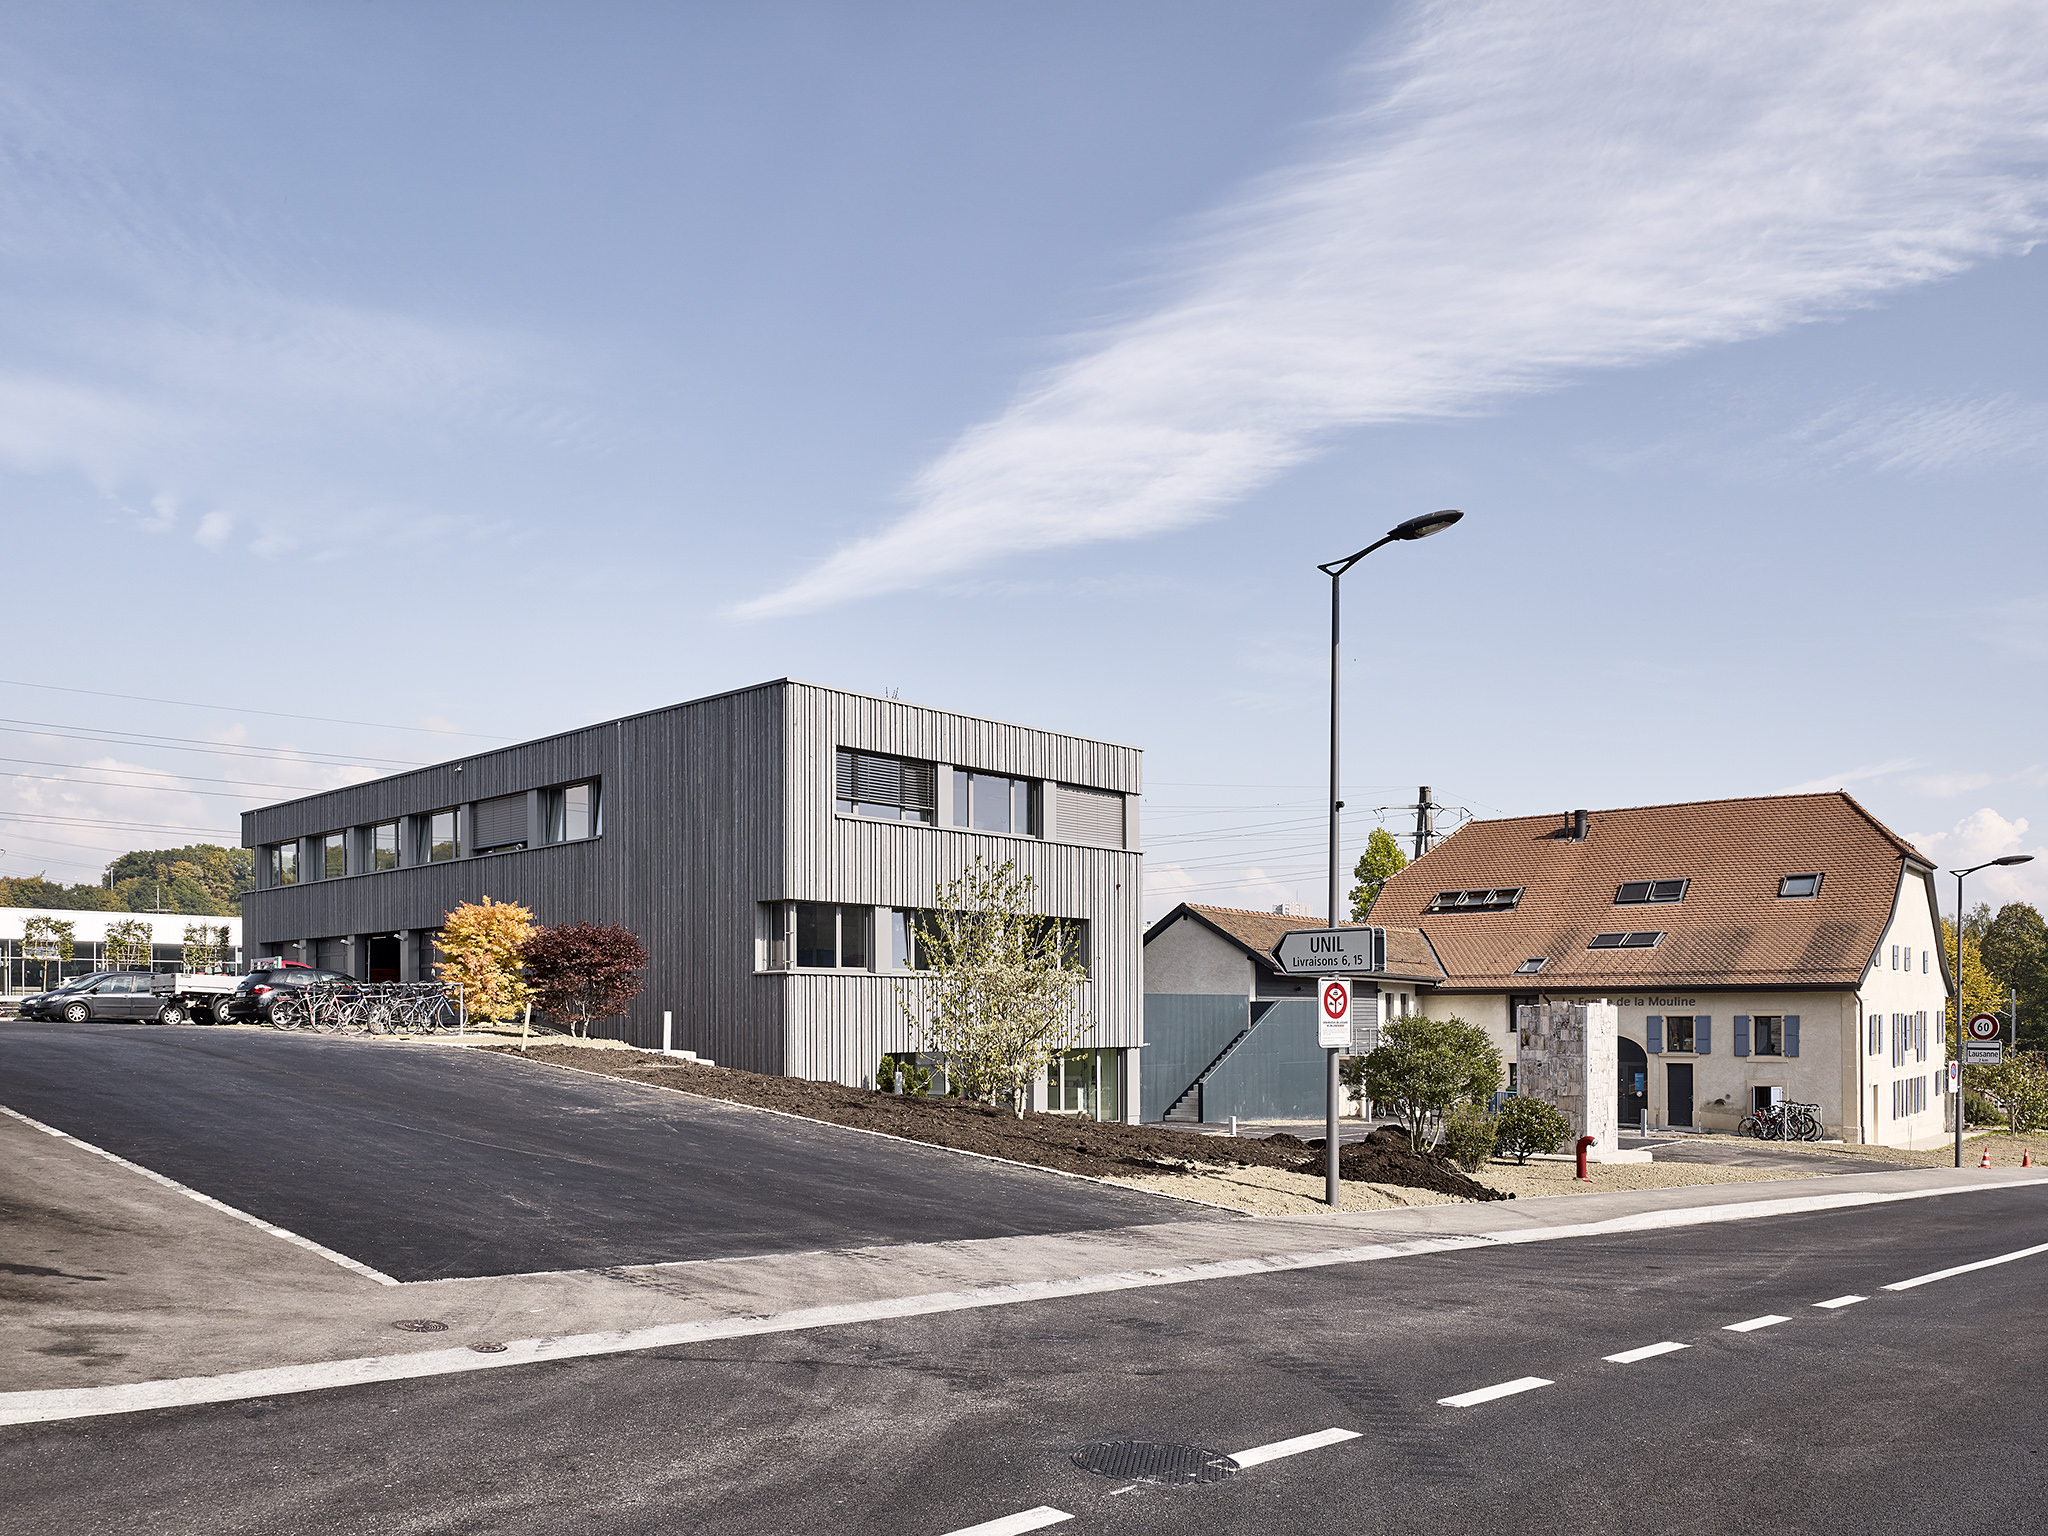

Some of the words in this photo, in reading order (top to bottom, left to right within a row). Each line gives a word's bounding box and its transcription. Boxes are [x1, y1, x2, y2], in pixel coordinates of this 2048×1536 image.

[1310, 936, 1344, 953] UNIL
[1293, 956, 1338, 967] Livraisons
[1341, 955, 1351, 967] 6,
[1353, 954, 1363, 965] 15
[1617, 997, 1631, 1007] de
[1634, 997, 1644, 1007] la
[1648, 997, 1696, 1007] Mouline
[1977, 1022, 1989, 1032] 60
